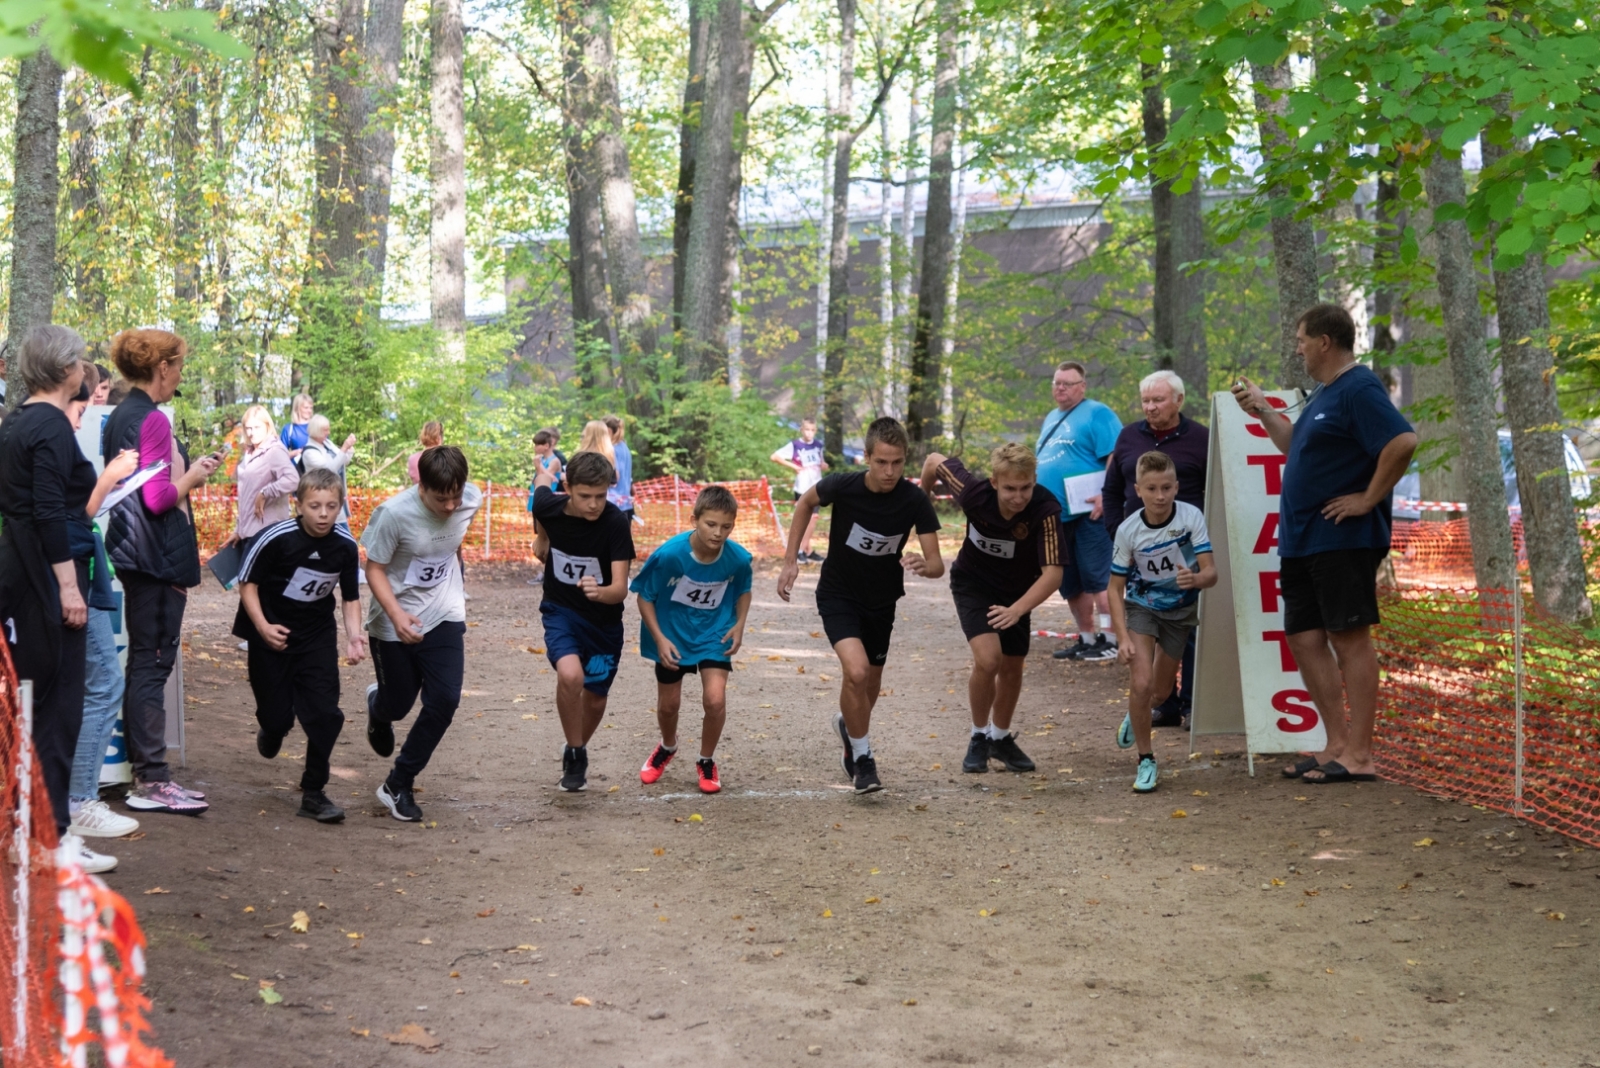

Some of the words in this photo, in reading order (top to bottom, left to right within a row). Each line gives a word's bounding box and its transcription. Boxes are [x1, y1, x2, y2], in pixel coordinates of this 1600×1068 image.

[859, 537, 889, 553] 37
[977, 540, 1002, 554] 45
[420, 562, 447, 582] 35
[563, 562, 587, 580] 47
[1147, 556, 1174, 575] 44
[1244, 396, 1319, 733] STARTS
[301, 579, 331, 596] 46
[686, 588, 712, 604] 41
